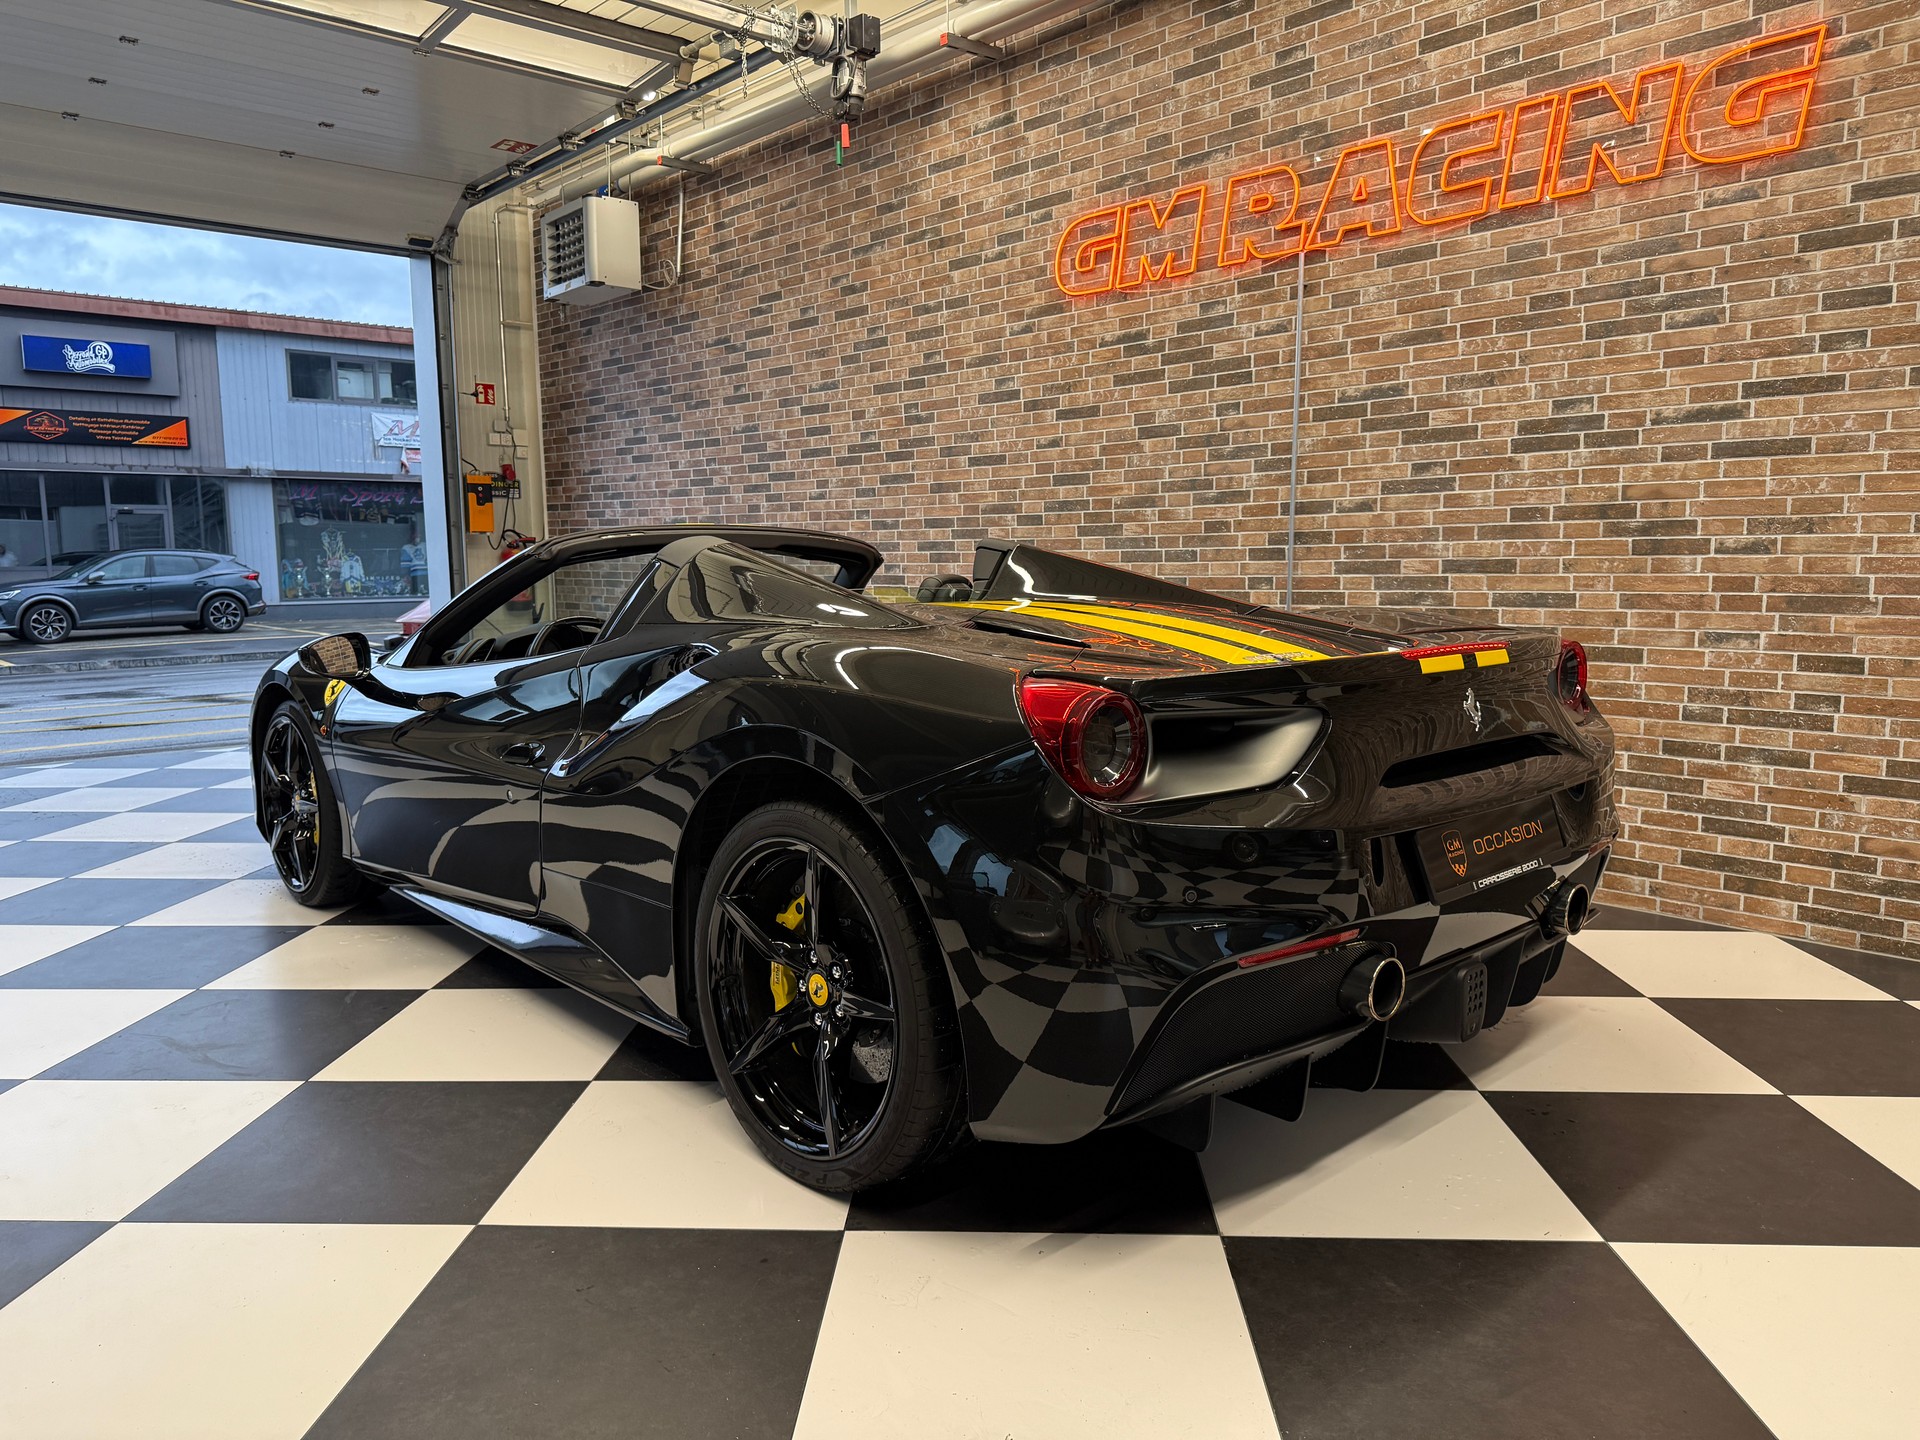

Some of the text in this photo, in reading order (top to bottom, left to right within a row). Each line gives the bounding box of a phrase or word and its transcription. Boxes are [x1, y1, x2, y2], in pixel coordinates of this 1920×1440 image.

[1055, 24, 1829, 297] GM RACING
[1446, 838, 1462, 851] GM
[1472, 819, 1544, 855] OCCASION
[1477, 860, 1539, 888] CARROSSERIE 2000
